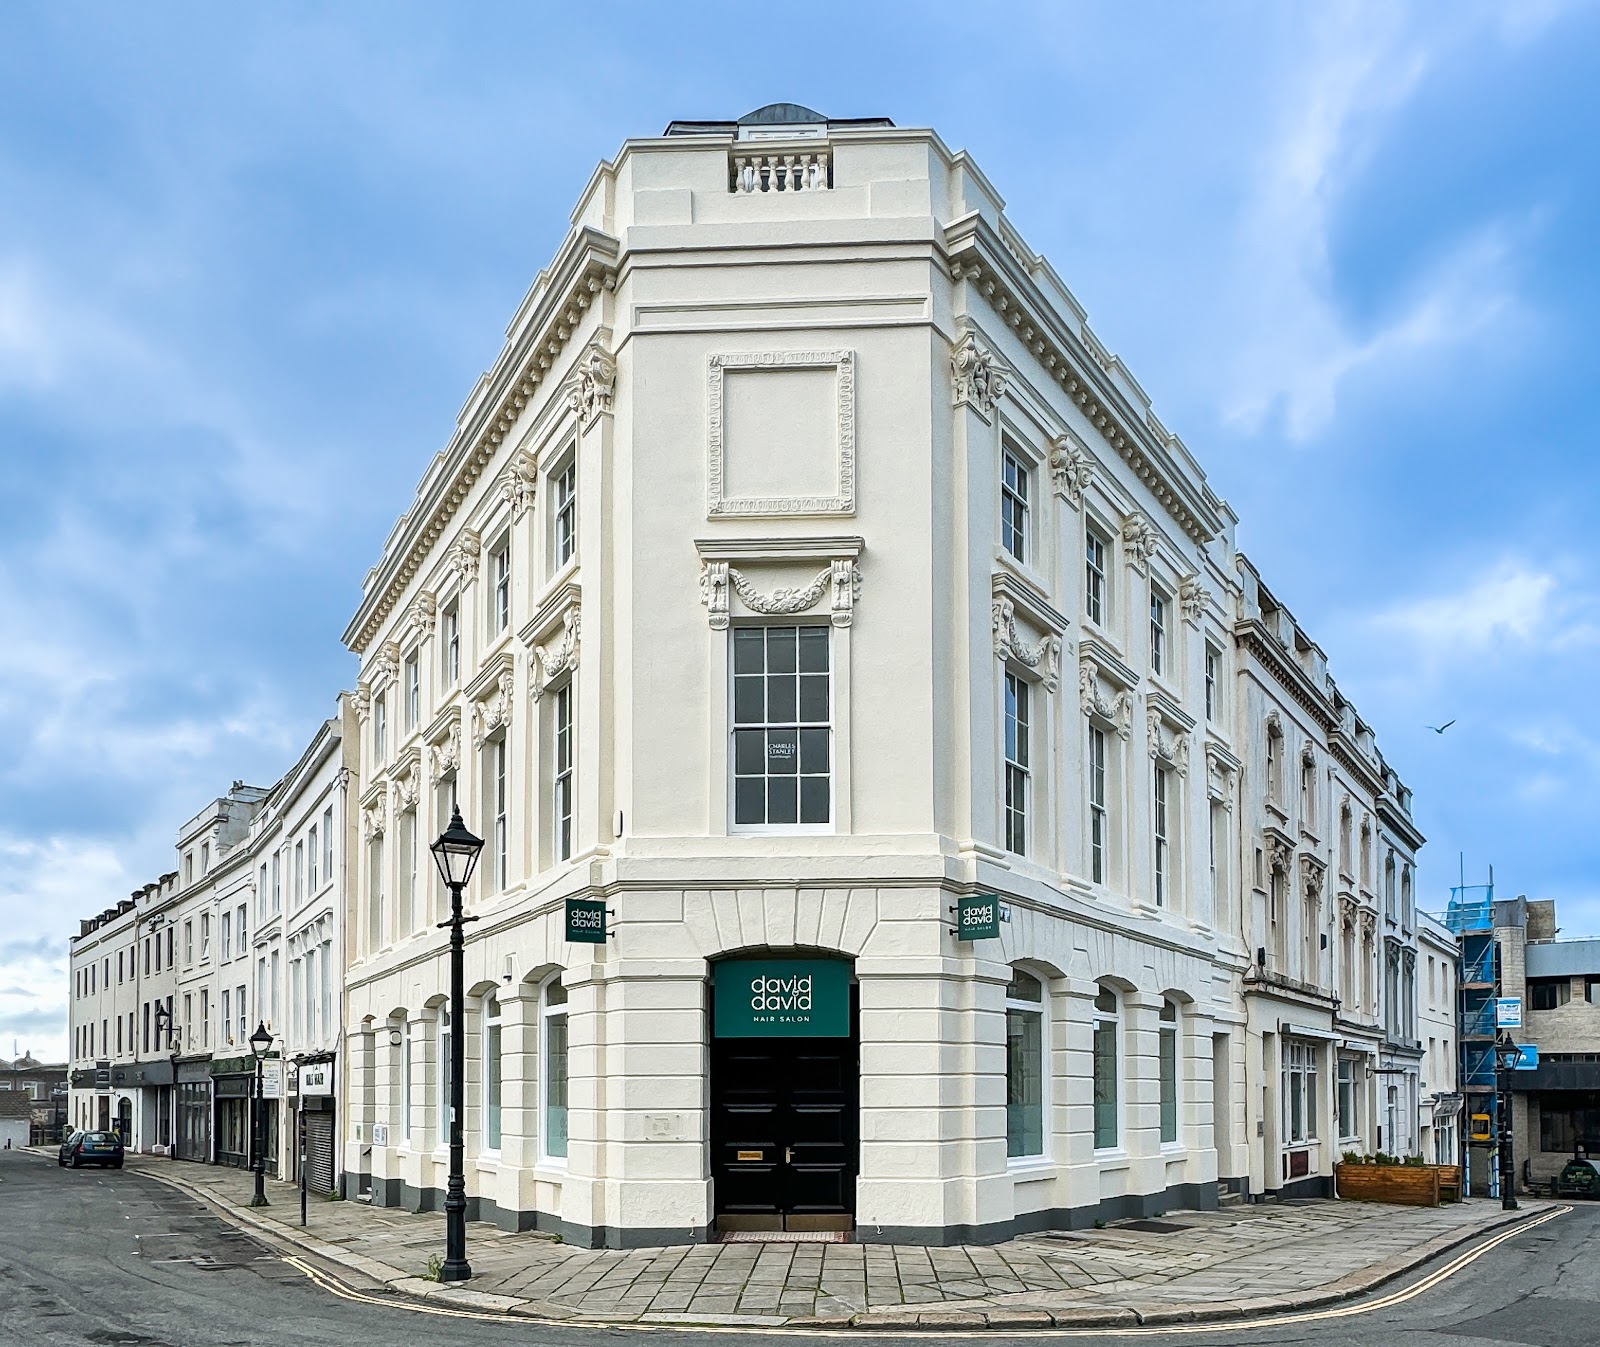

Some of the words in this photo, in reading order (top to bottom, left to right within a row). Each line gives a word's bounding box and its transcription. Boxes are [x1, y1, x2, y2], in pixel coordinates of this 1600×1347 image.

[571, 908, 602, 919] david
[963, 904, 992, 916] david
[571, 918, 602, 928] david
[963, 915, 992, 925] david
[751, 975, 811, 993] david
[751, 993, 811, 1010] david
